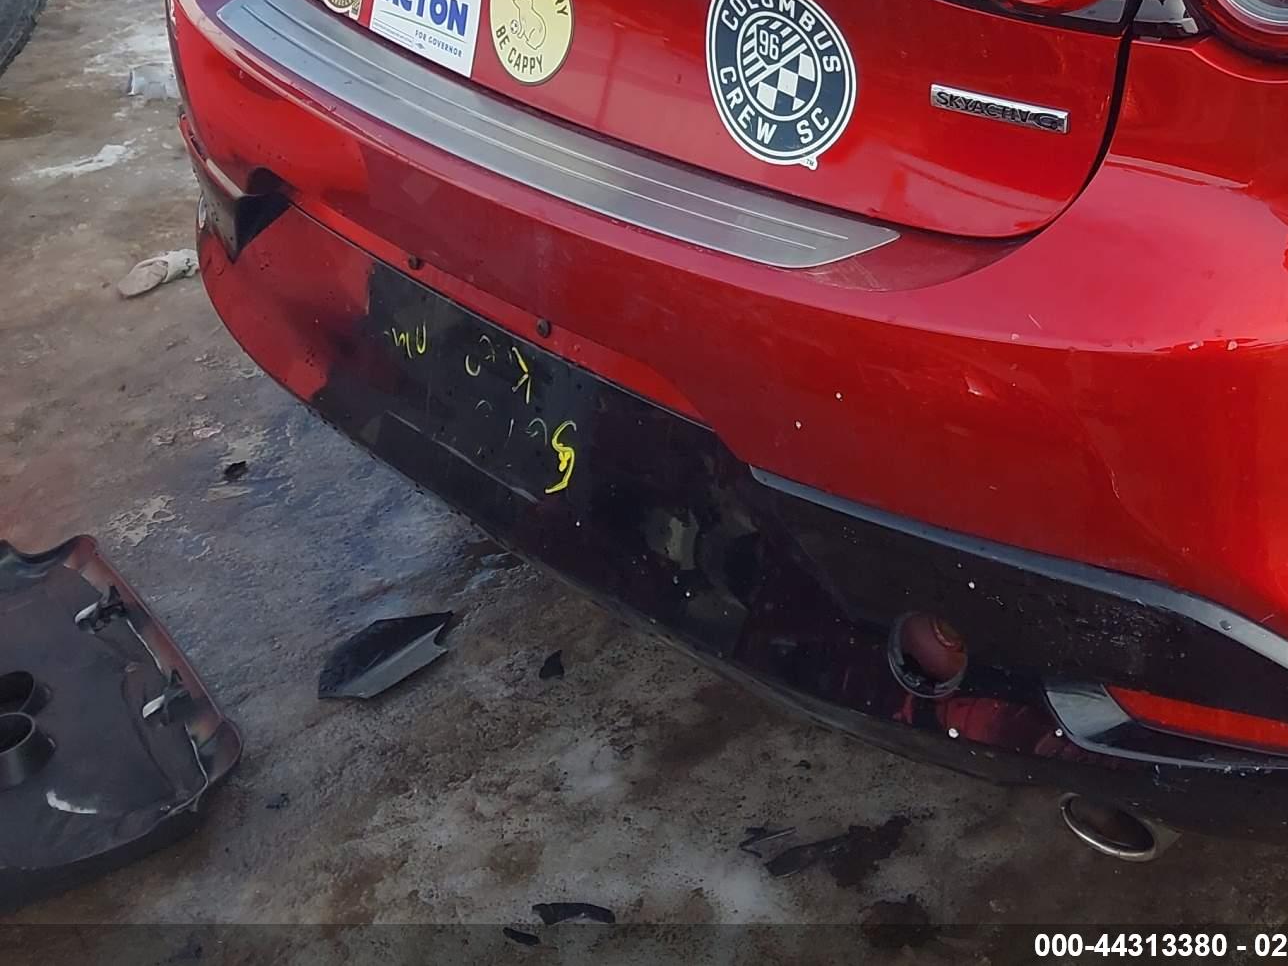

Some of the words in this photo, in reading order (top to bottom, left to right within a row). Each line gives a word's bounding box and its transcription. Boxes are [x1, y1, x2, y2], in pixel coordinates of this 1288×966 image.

[415, 29, 427, 41] FOR
[428, 36, 462, 58] GOVERNOR
[496, 25, 510, 50] BE
[507, 47, 543, 74] CAPPY
[759, 29, 780, 60] 96
[720, 66, 777, 145] CREW
[796, 107, 829, 144] SC
